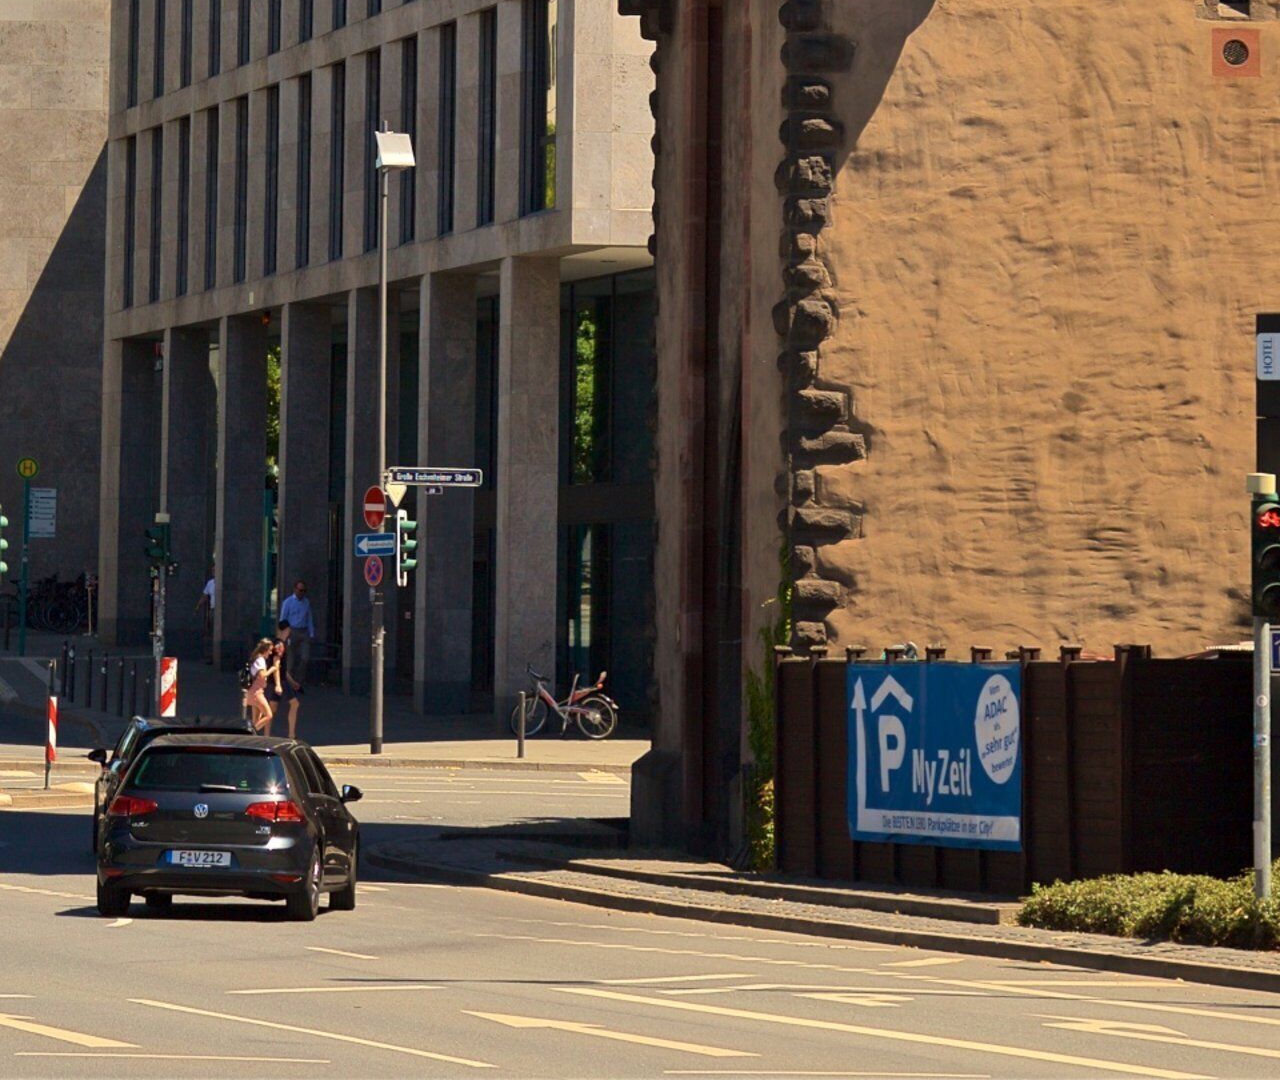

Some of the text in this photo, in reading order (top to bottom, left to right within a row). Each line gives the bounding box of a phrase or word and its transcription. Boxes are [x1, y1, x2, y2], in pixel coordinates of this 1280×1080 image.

[1263, 337, 1272, 375] HOTEL
[984, 695, 1008, 722] ADAC
[878, 715, 906, 792] P
[912, 748, 972, 805] MyZeil
[203, 852, 223, 864] 212
